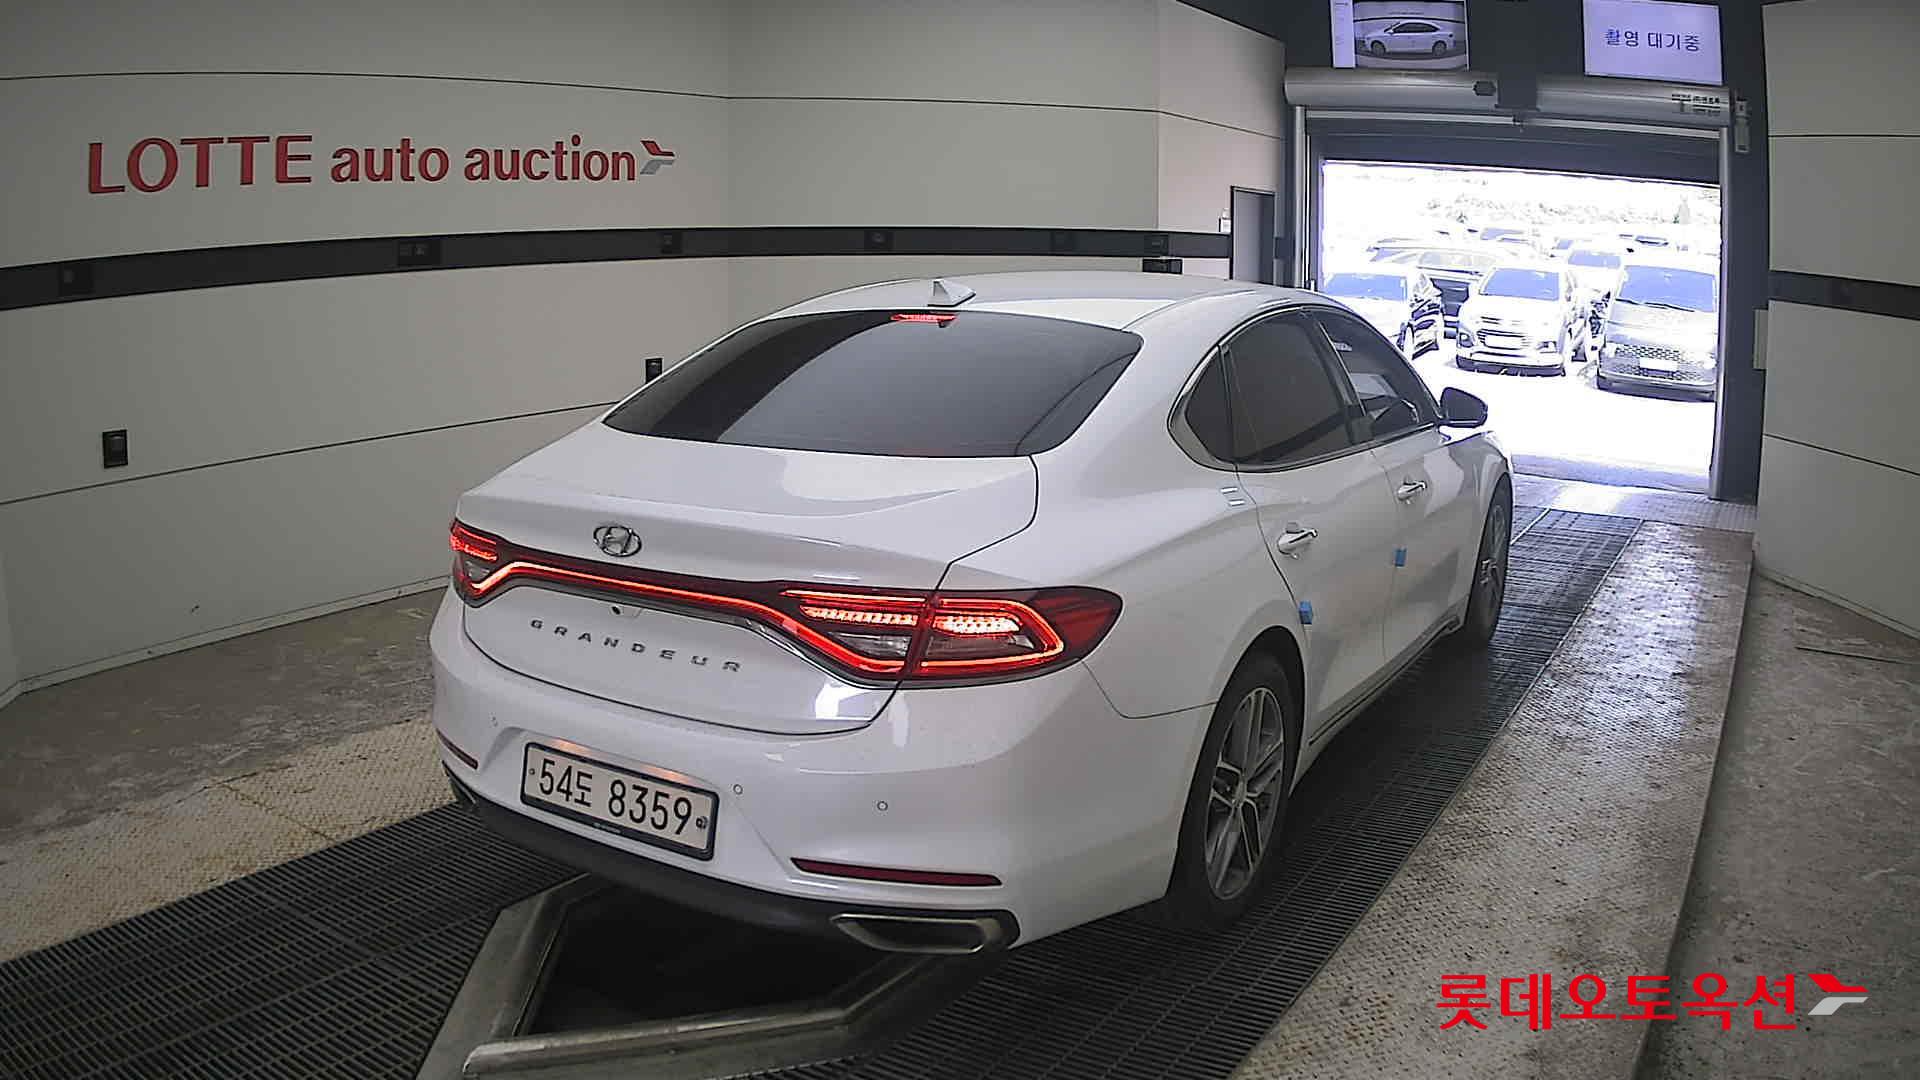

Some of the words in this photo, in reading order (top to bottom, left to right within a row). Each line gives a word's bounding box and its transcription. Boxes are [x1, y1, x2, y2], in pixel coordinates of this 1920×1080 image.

[1646, 31, 1701, 52] 대기중
[88, 134, 313, 194] LOTTE
[331, 137, 450, 183] auto
[463, 133, 637, 183] auction
[530, 618, 742, 673] GRANDEUR
[539, 757, 593, 808] 54도
[608, 779, 693, 835] 8359
